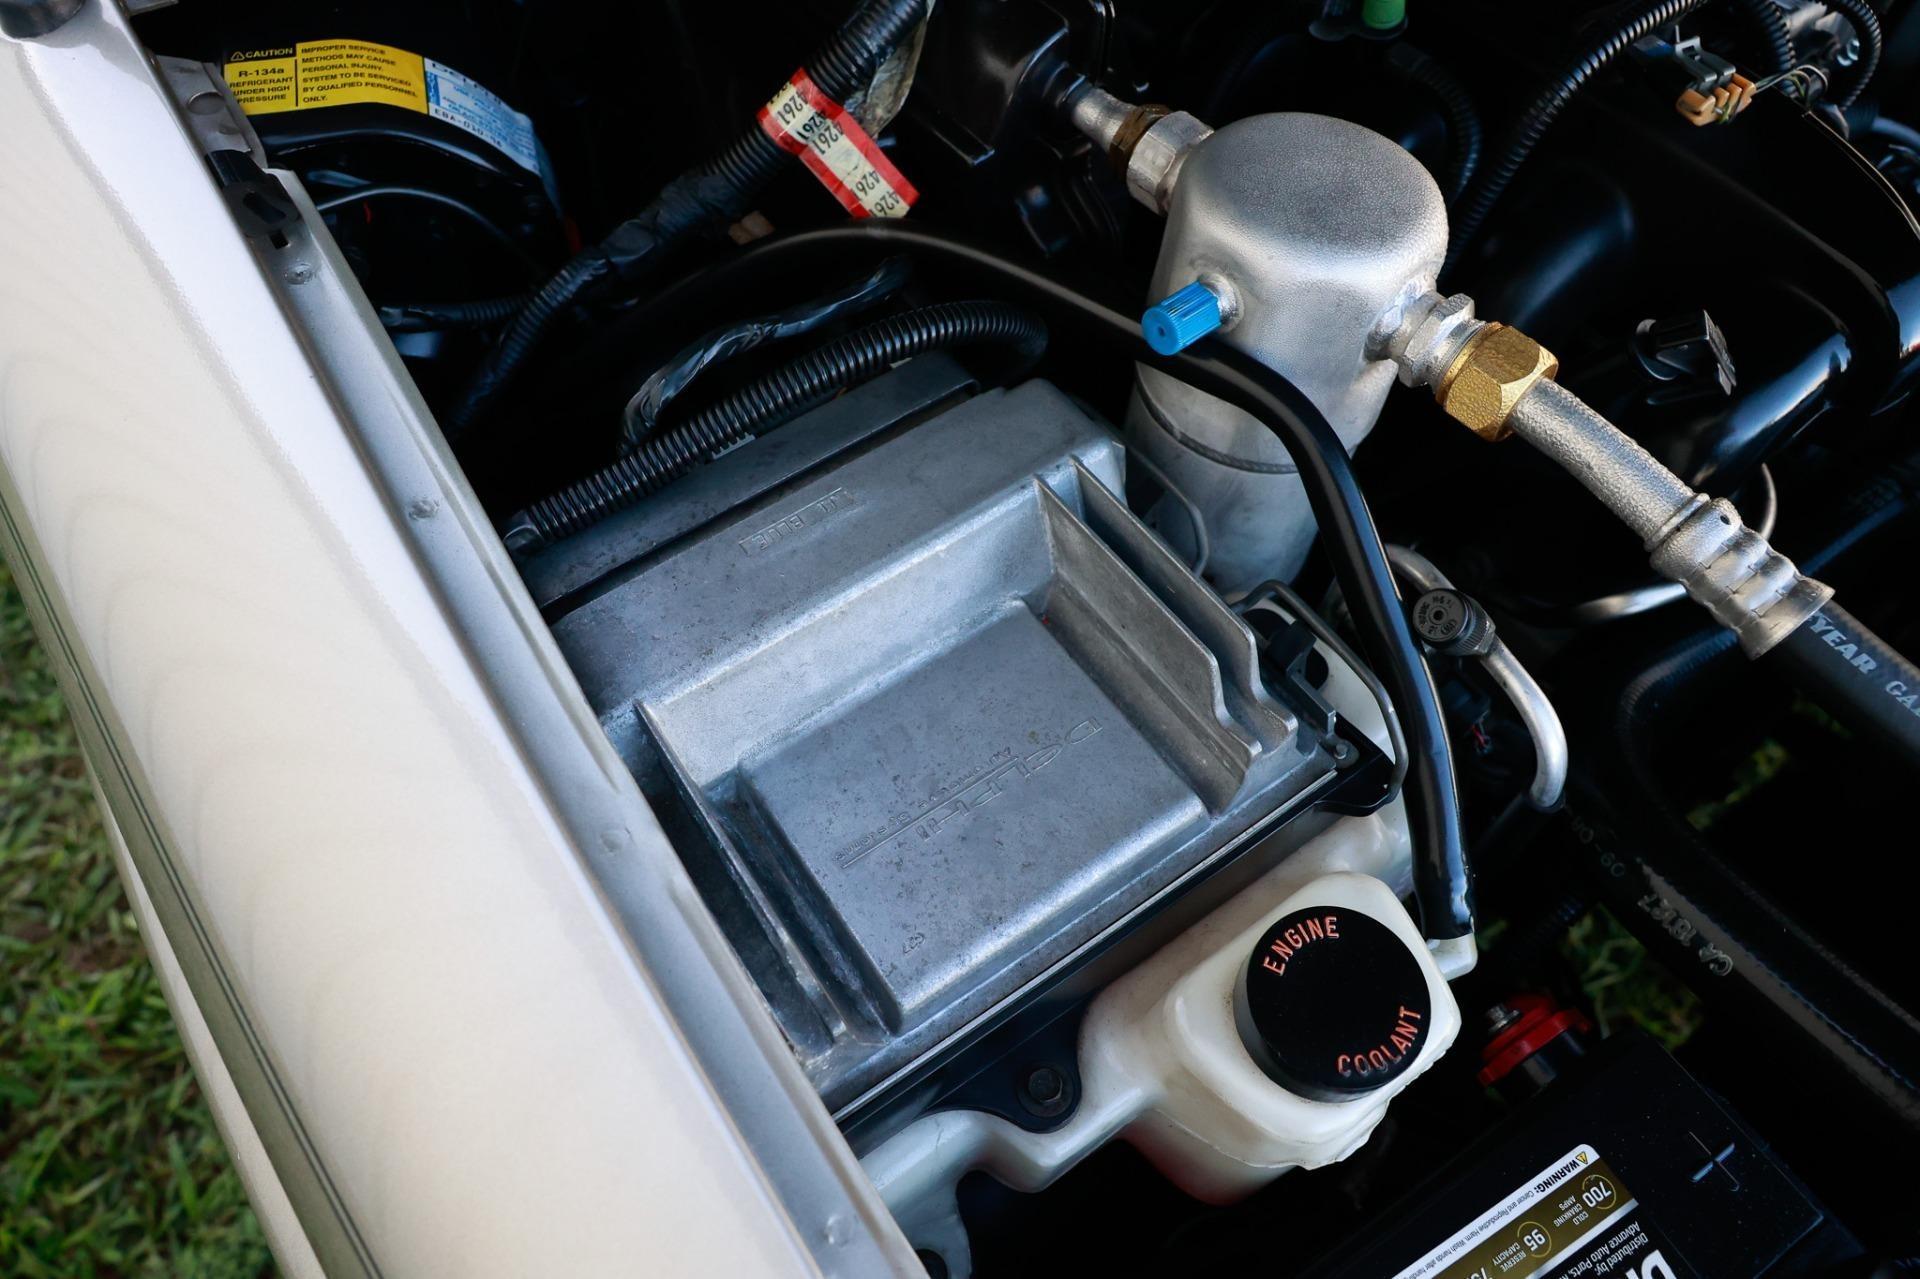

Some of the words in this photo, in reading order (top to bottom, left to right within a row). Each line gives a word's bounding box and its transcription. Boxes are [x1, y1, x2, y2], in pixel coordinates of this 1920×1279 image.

[245, 48, 293, 59] CAUTION
[301, 44, 347, 54] IMPROPER
[348, 44, 386, 54] SERVICE
[302, 54, 344, 64] METHODS
[346, 53, 365, 61] MAY
[367, 55, 397, 66] CAUSE
[302, 63, 349, 73] PERSONAL
[238, 67, 286, 78] R-134a
[302, 74, 338, 84] SYSTEM
[367, 72, 412, 87] SERVICED
[229, 76, 294, 88] REFRIGERANT
[317, 82, 364, 92] QUALIFIED
[365, 82, 418, 98] PERSONNEL
[233, 87, 266, 97] UNDER
[267, 85, 290, 93] HIGH
[237, 94, 287, 104] PRESSURE
[777, 90, 809, 126] 4261
[796, 110, 827, 140] 4261
[812, 121, 844, 156] 4261
[1807, 611, 1877, 674] YEAR
[1264, 916, 1340, 977] ENGINE
[1337, 1006, 1421, 1078] COOLANT
[1534, 1159, 1580, 1194] WARNING:
[1516, 1190, 1534, 1205] Cancer
[1582, 1180, 1612, 1208] 700
[1506, 1201, 1518, 1212] and
[1558, 1195, 1576, 1211] AMPS
[1478, 1208, 1510, 1232] Reproductive
[1553, 1204, 1583, 1228] CRANKING
[1572, 1212, 1589, 1226] COLD
[1522, 1228, 1546, 1252] 95
[1608, 1220, 1641, 1249] Advance
[1450, 1240, 1466, 1252] Wash
[1492, 1242, 1521, 1267] CAPACITY
[1590, 1243, 1610, 1262] Auto
[1606, 1232, 1649, 1270] Distributed
[1435, 1248, 1452, 1262] hands
[1500, 1251, 1526, 1273] RESERVE
[1424, 1258, 1437, 1270] after
[1567, 1258, 1593, 1278] Parts,
[1594, 1263, 1610, 1276] by:
[1625, 1249, 1677, 1279] D
